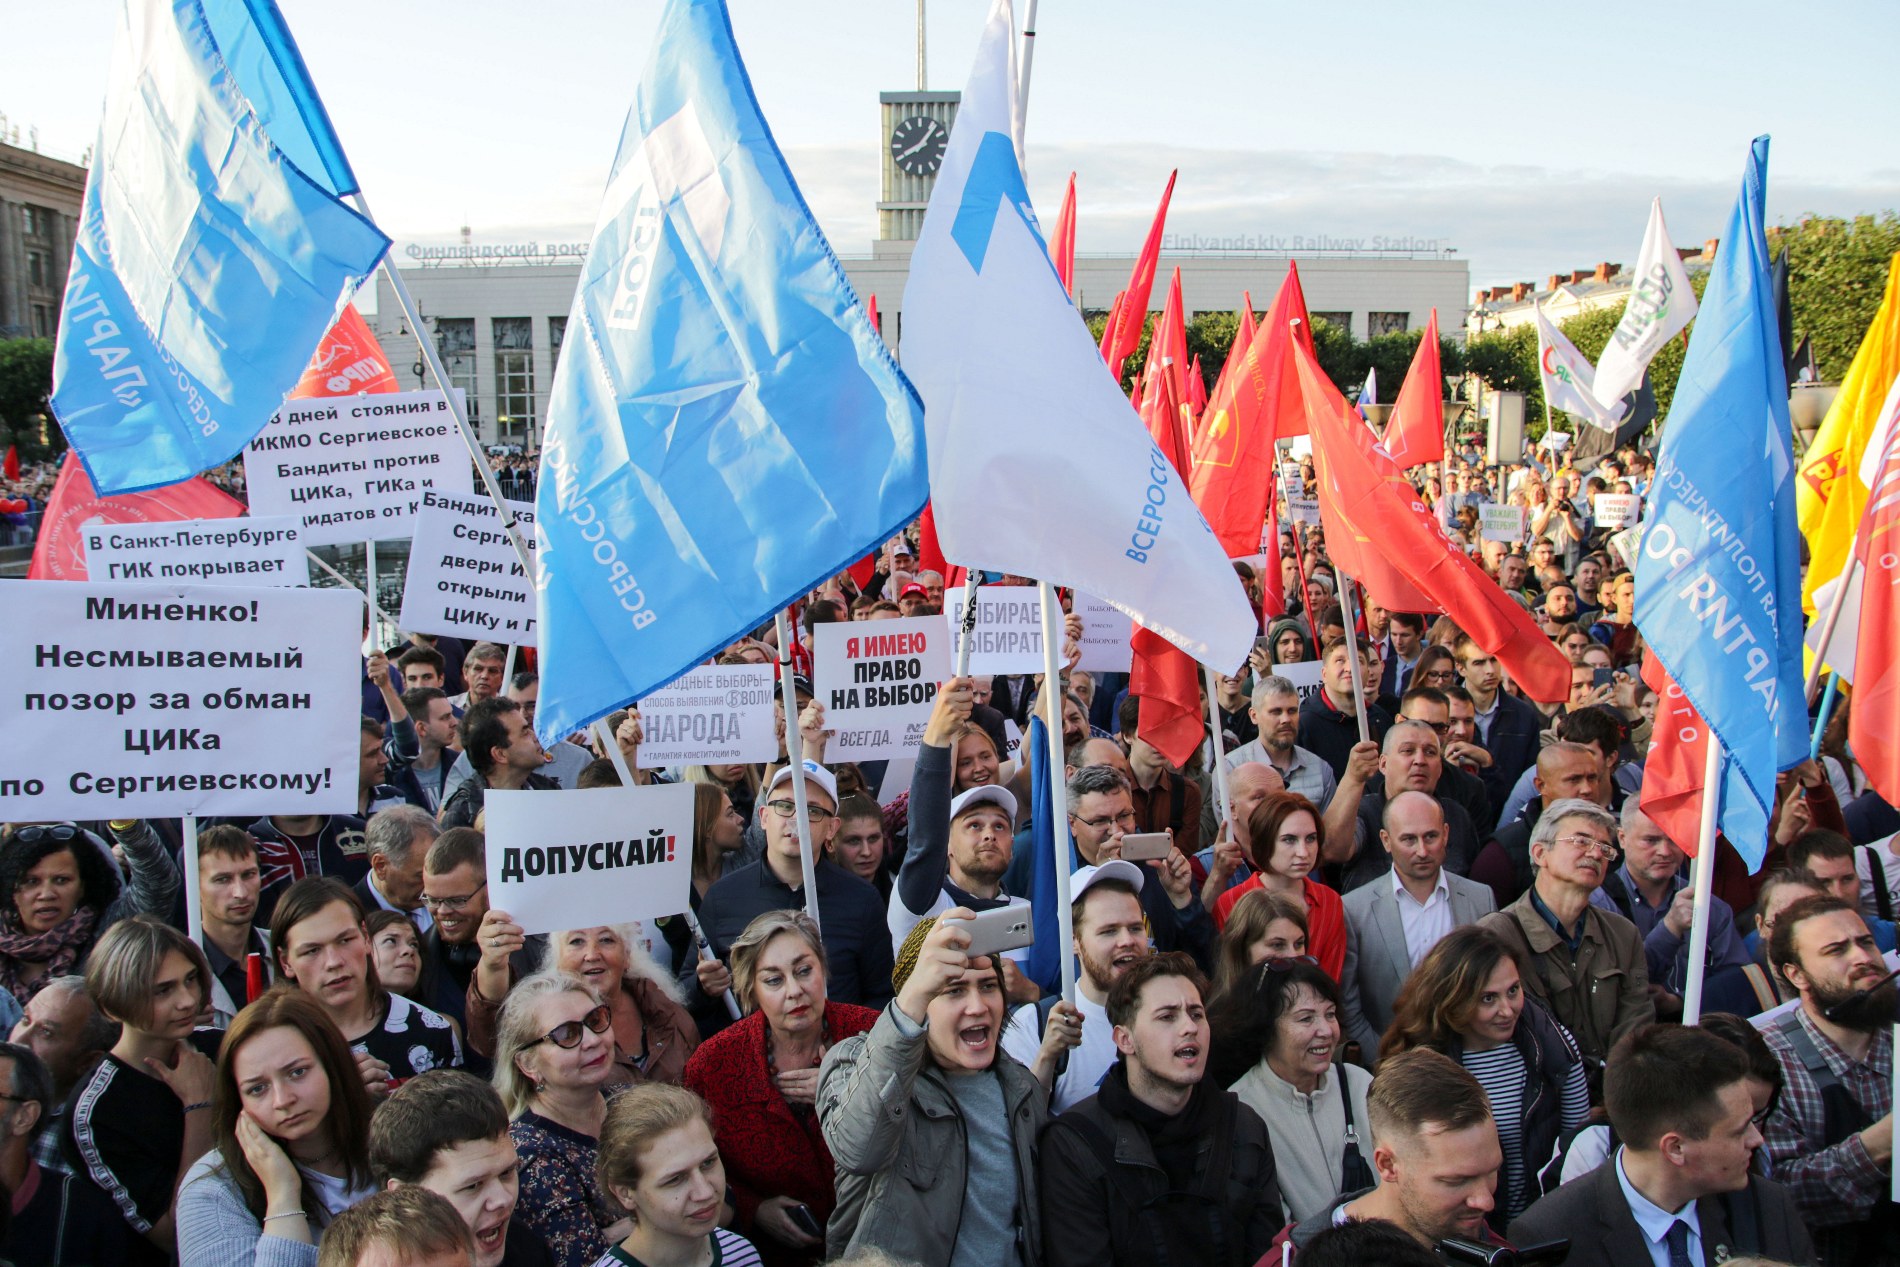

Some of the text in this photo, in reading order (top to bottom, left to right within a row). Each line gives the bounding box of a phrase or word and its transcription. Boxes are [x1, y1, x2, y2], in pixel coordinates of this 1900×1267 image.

[405, 242, 539, 257] Финляндский
[1163, 233, 1438, 253] Finlyandskiy Railway Station
[288, 407, 339, 426] дней
[351, 400, 430, 418] стояния
[437, 400, 447, 411] в
[250, 434, 311, 451] ИКМО
[319, 424, 447, 447] Сергиевское
[277, 453, 440, 478] Бандиты против
[290, 478, 433, 504] ЦИКа, ГИКа и
[382, 506, 402, 517] от
[422, 491, 498, 517] Бандит
[89, 528, 297, 551] В Санкт-Петербурге
[453, 523, 536, 550] Сергив
[108, 559, 285, 581] ГИК покрывает
[440, 555, 504, 574] двери
[437, 580, 527, 603] открыли
[86, 597, 258, 622] Миненко!
[443, 606, 500, 631] ЦИКу
[506, 619, 518, 630] и
[35, 644, 303, 668] Несмываемый
[847, 631, 926, 659] Я ИМЕЮ
[854, 658, 921, 683] ПРАВО
[25, 687, 311, 715] позор за обман
[644, 697, 675, 708] СПОСОБ
[676, 696, 724, 707] ВЫЯВЛЕНИЯ
[831, 689, 860, 710] НА
[125, 728, 221, 755] ЦИКа
[839, 729, 893, 748] ВСЕГДА.
[649, 752, 682, 761] ГАРАНТИЯ
[683, 750, 730, 760] КОНСТИТУЦИИ
[1, 768, 332, 798] по Сергиевскому!
[501, 829, 676, 883] ДОПУСКАЙ!
